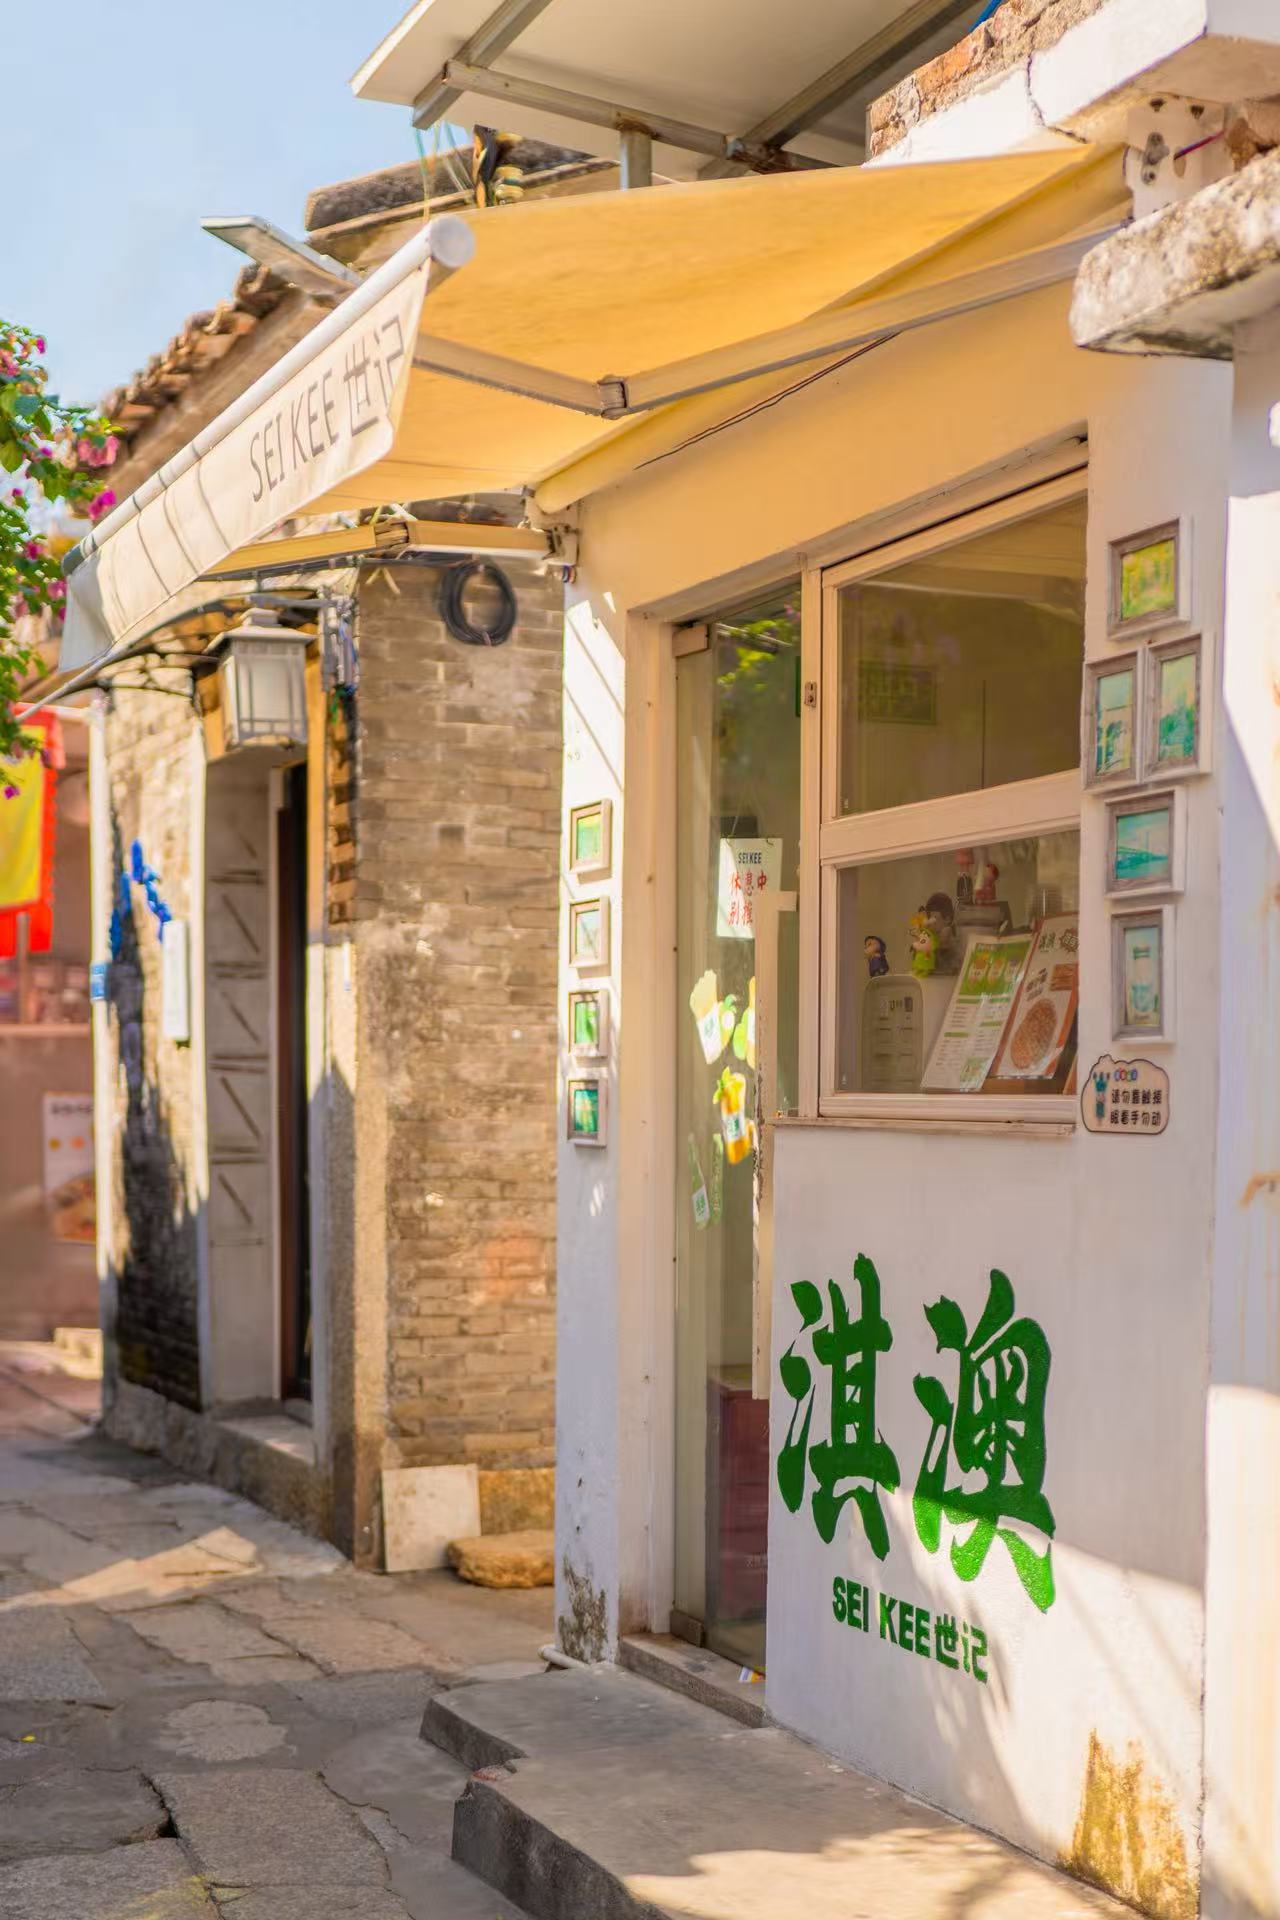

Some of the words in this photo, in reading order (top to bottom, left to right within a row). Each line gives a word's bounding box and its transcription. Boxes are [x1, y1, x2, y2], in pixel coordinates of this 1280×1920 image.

[250, 412, 286, 503] SEI
[291, 367, 340, 471] KEE
[344, 314, 404, 437] 世记
[729, 870, 767, 896] 休息中
[1110, 1109, 1161, 1126] 眼看手勿动
[777, 1252, 1056, 1614] 淇澳
[832, 1576, 869, 1633] SEI
[880, 1592, 931, 1659] KEE
[934, 1613, 988, 1685] 世记
